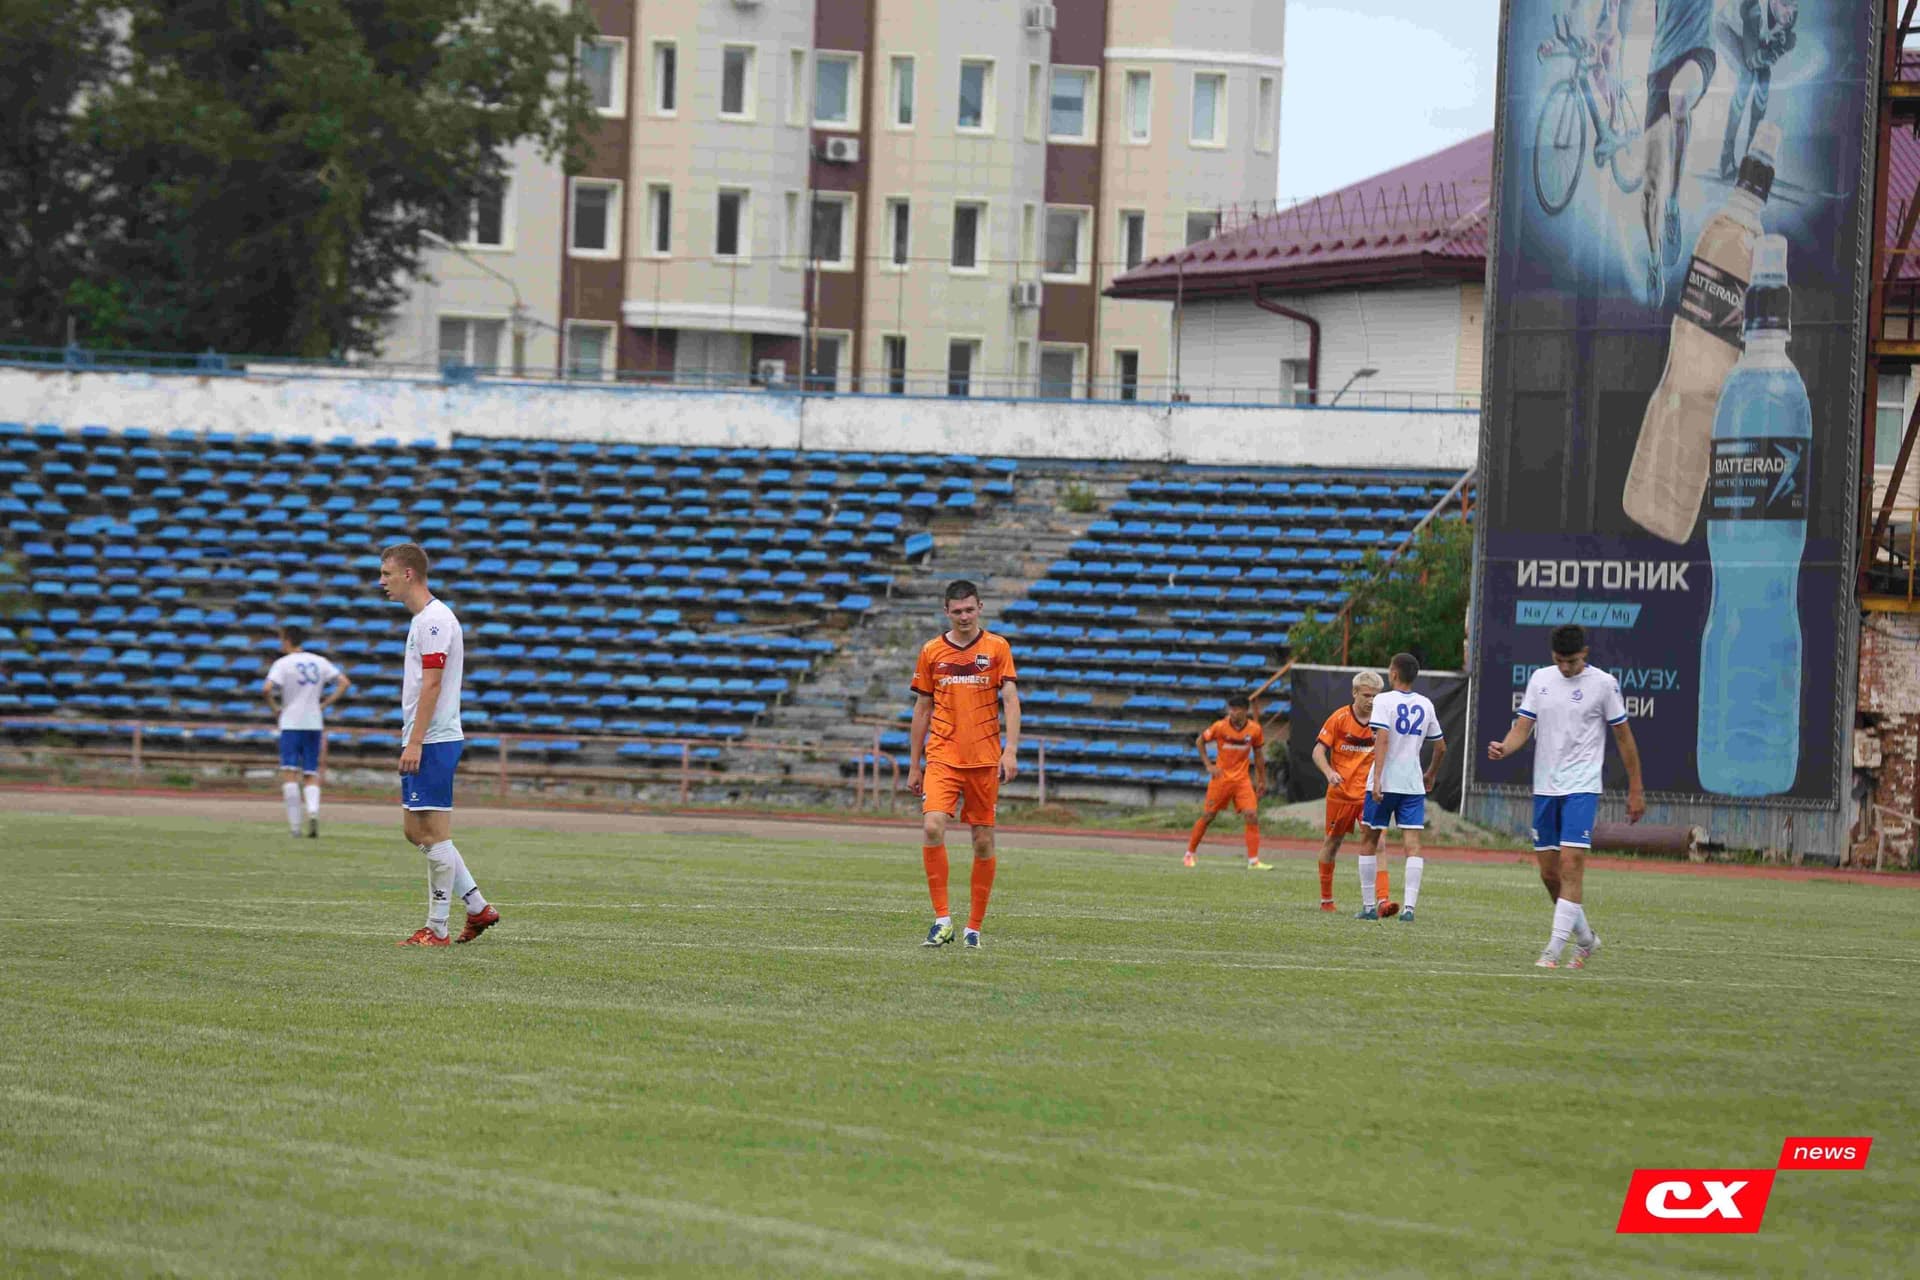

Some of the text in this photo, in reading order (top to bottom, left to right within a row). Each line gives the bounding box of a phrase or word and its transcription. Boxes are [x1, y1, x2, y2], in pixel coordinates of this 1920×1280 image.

[1516, 560, 1690, 591] ИЗОТОНИК
[1523, 607, 1631, 624] Na K Ca Mg
[295, 662, 320, 685] 33
[1395, 703, 1425, 736] 82
